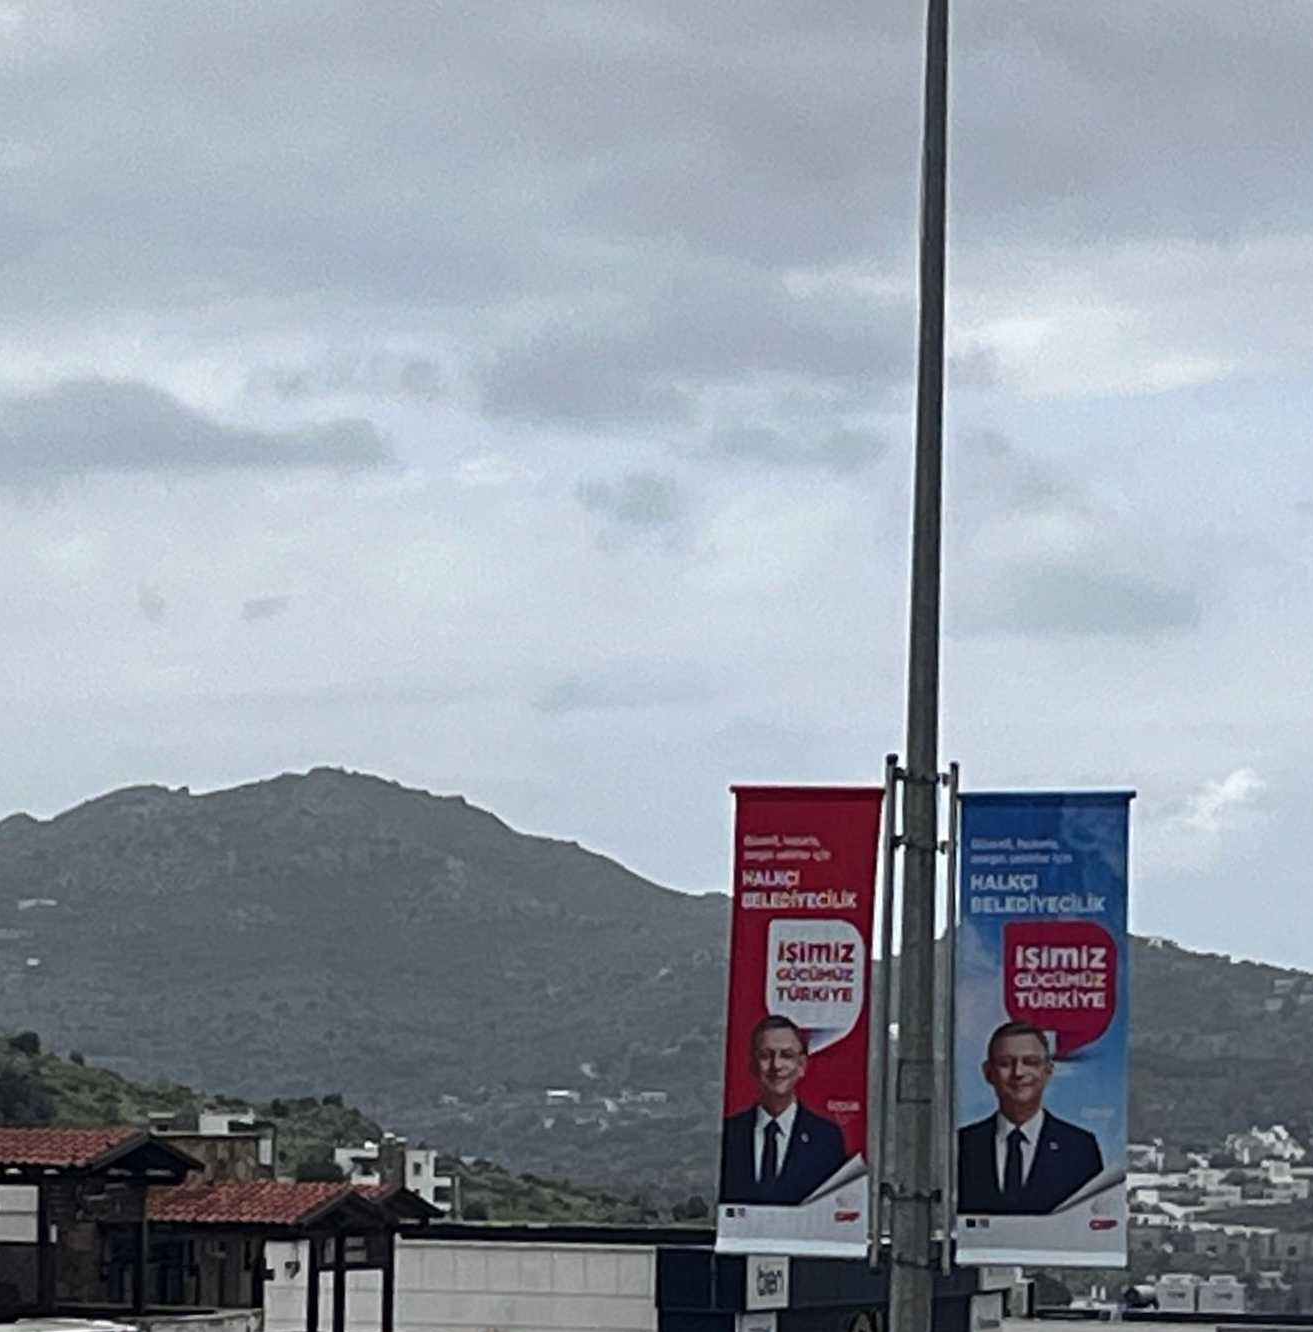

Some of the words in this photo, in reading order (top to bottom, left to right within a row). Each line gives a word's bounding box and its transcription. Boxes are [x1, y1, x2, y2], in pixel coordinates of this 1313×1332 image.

[970, 873, 1038, 892] HALKÇI
[970, 893, 1106, 914] BELEDİYECİLİK
[776, 985, 853, 1002] TÜRKİYE
[1015, 990, 1106, 1009] TÜRKİYE
